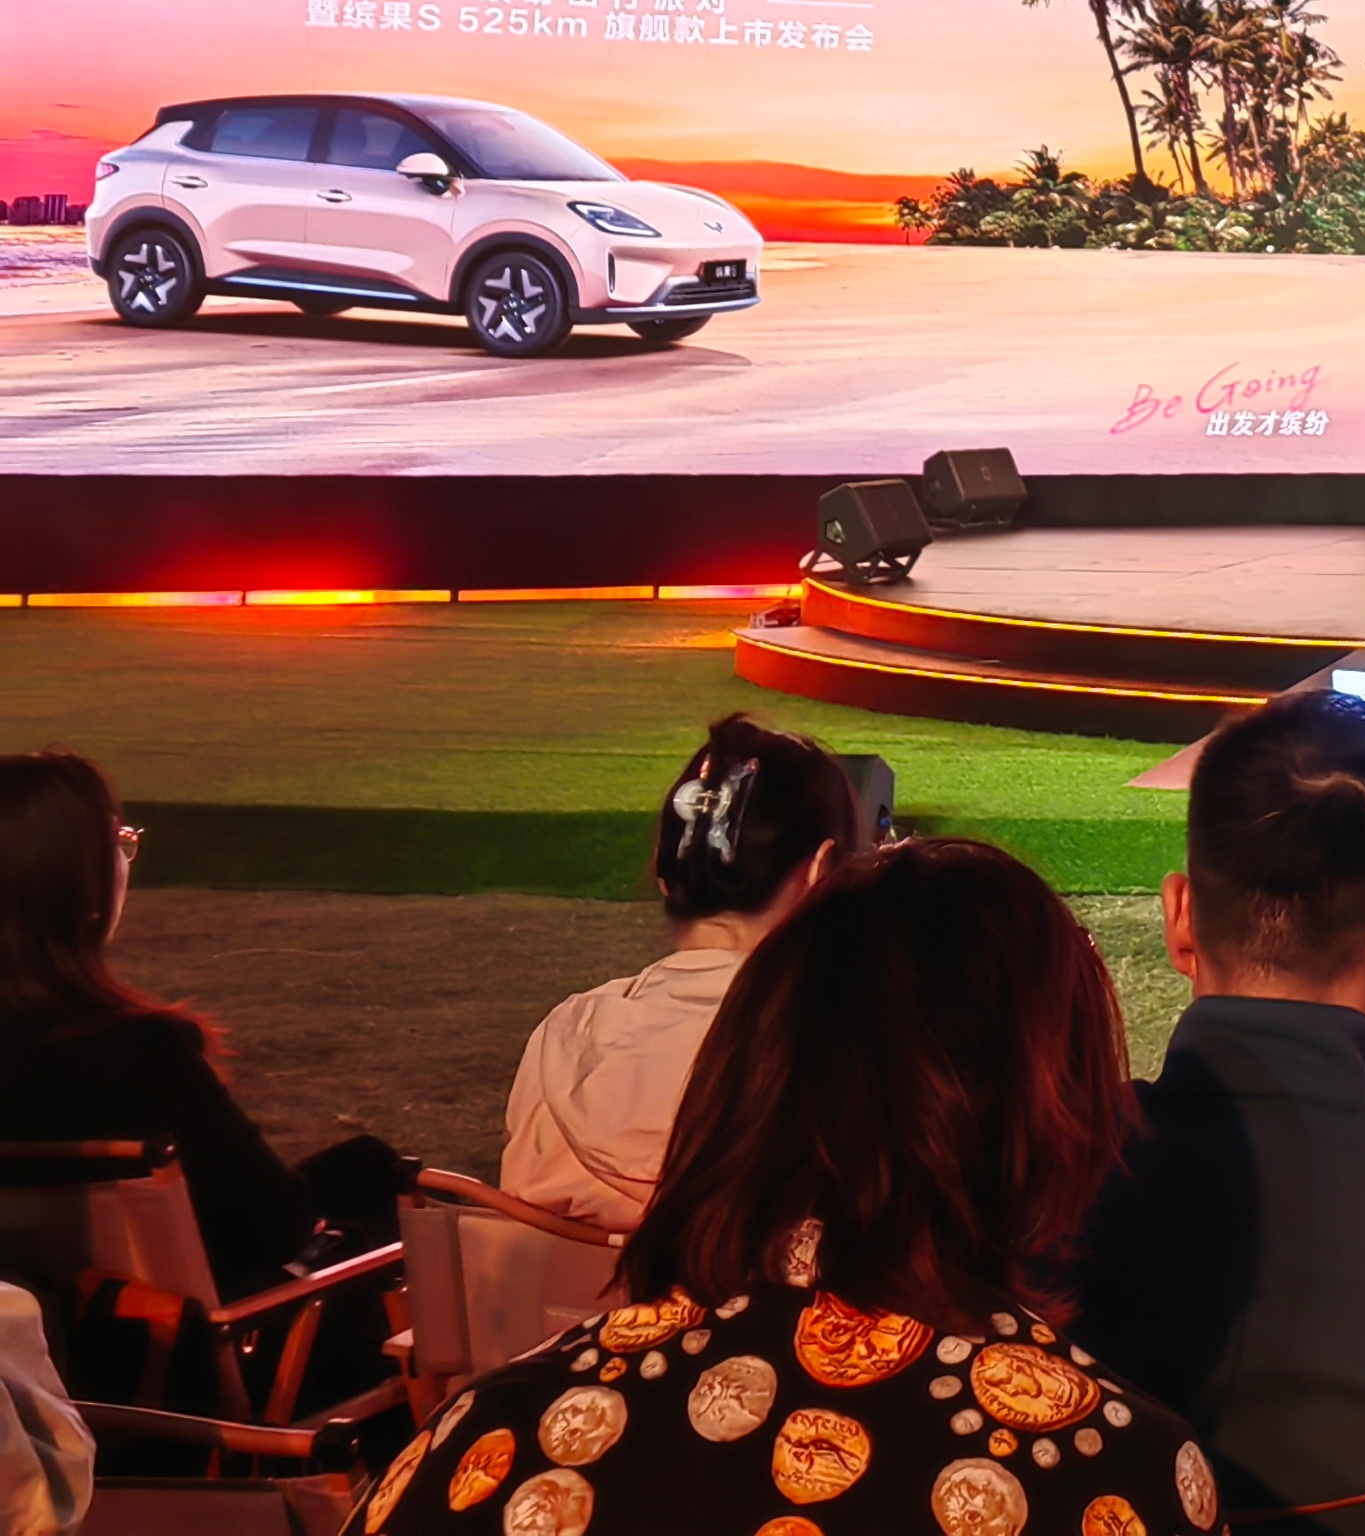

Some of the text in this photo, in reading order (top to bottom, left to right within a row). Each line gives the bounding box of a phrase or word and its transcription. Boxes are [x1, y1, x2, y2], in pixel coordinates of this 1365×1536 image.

[458, 7, 588, 38] 525km
[604, 12, 874, 52] 旗舰款上市发布会
[1109, 361, 1330, 435] Be Going
[1205, 409, 1330, 437] 出发才缤纷
